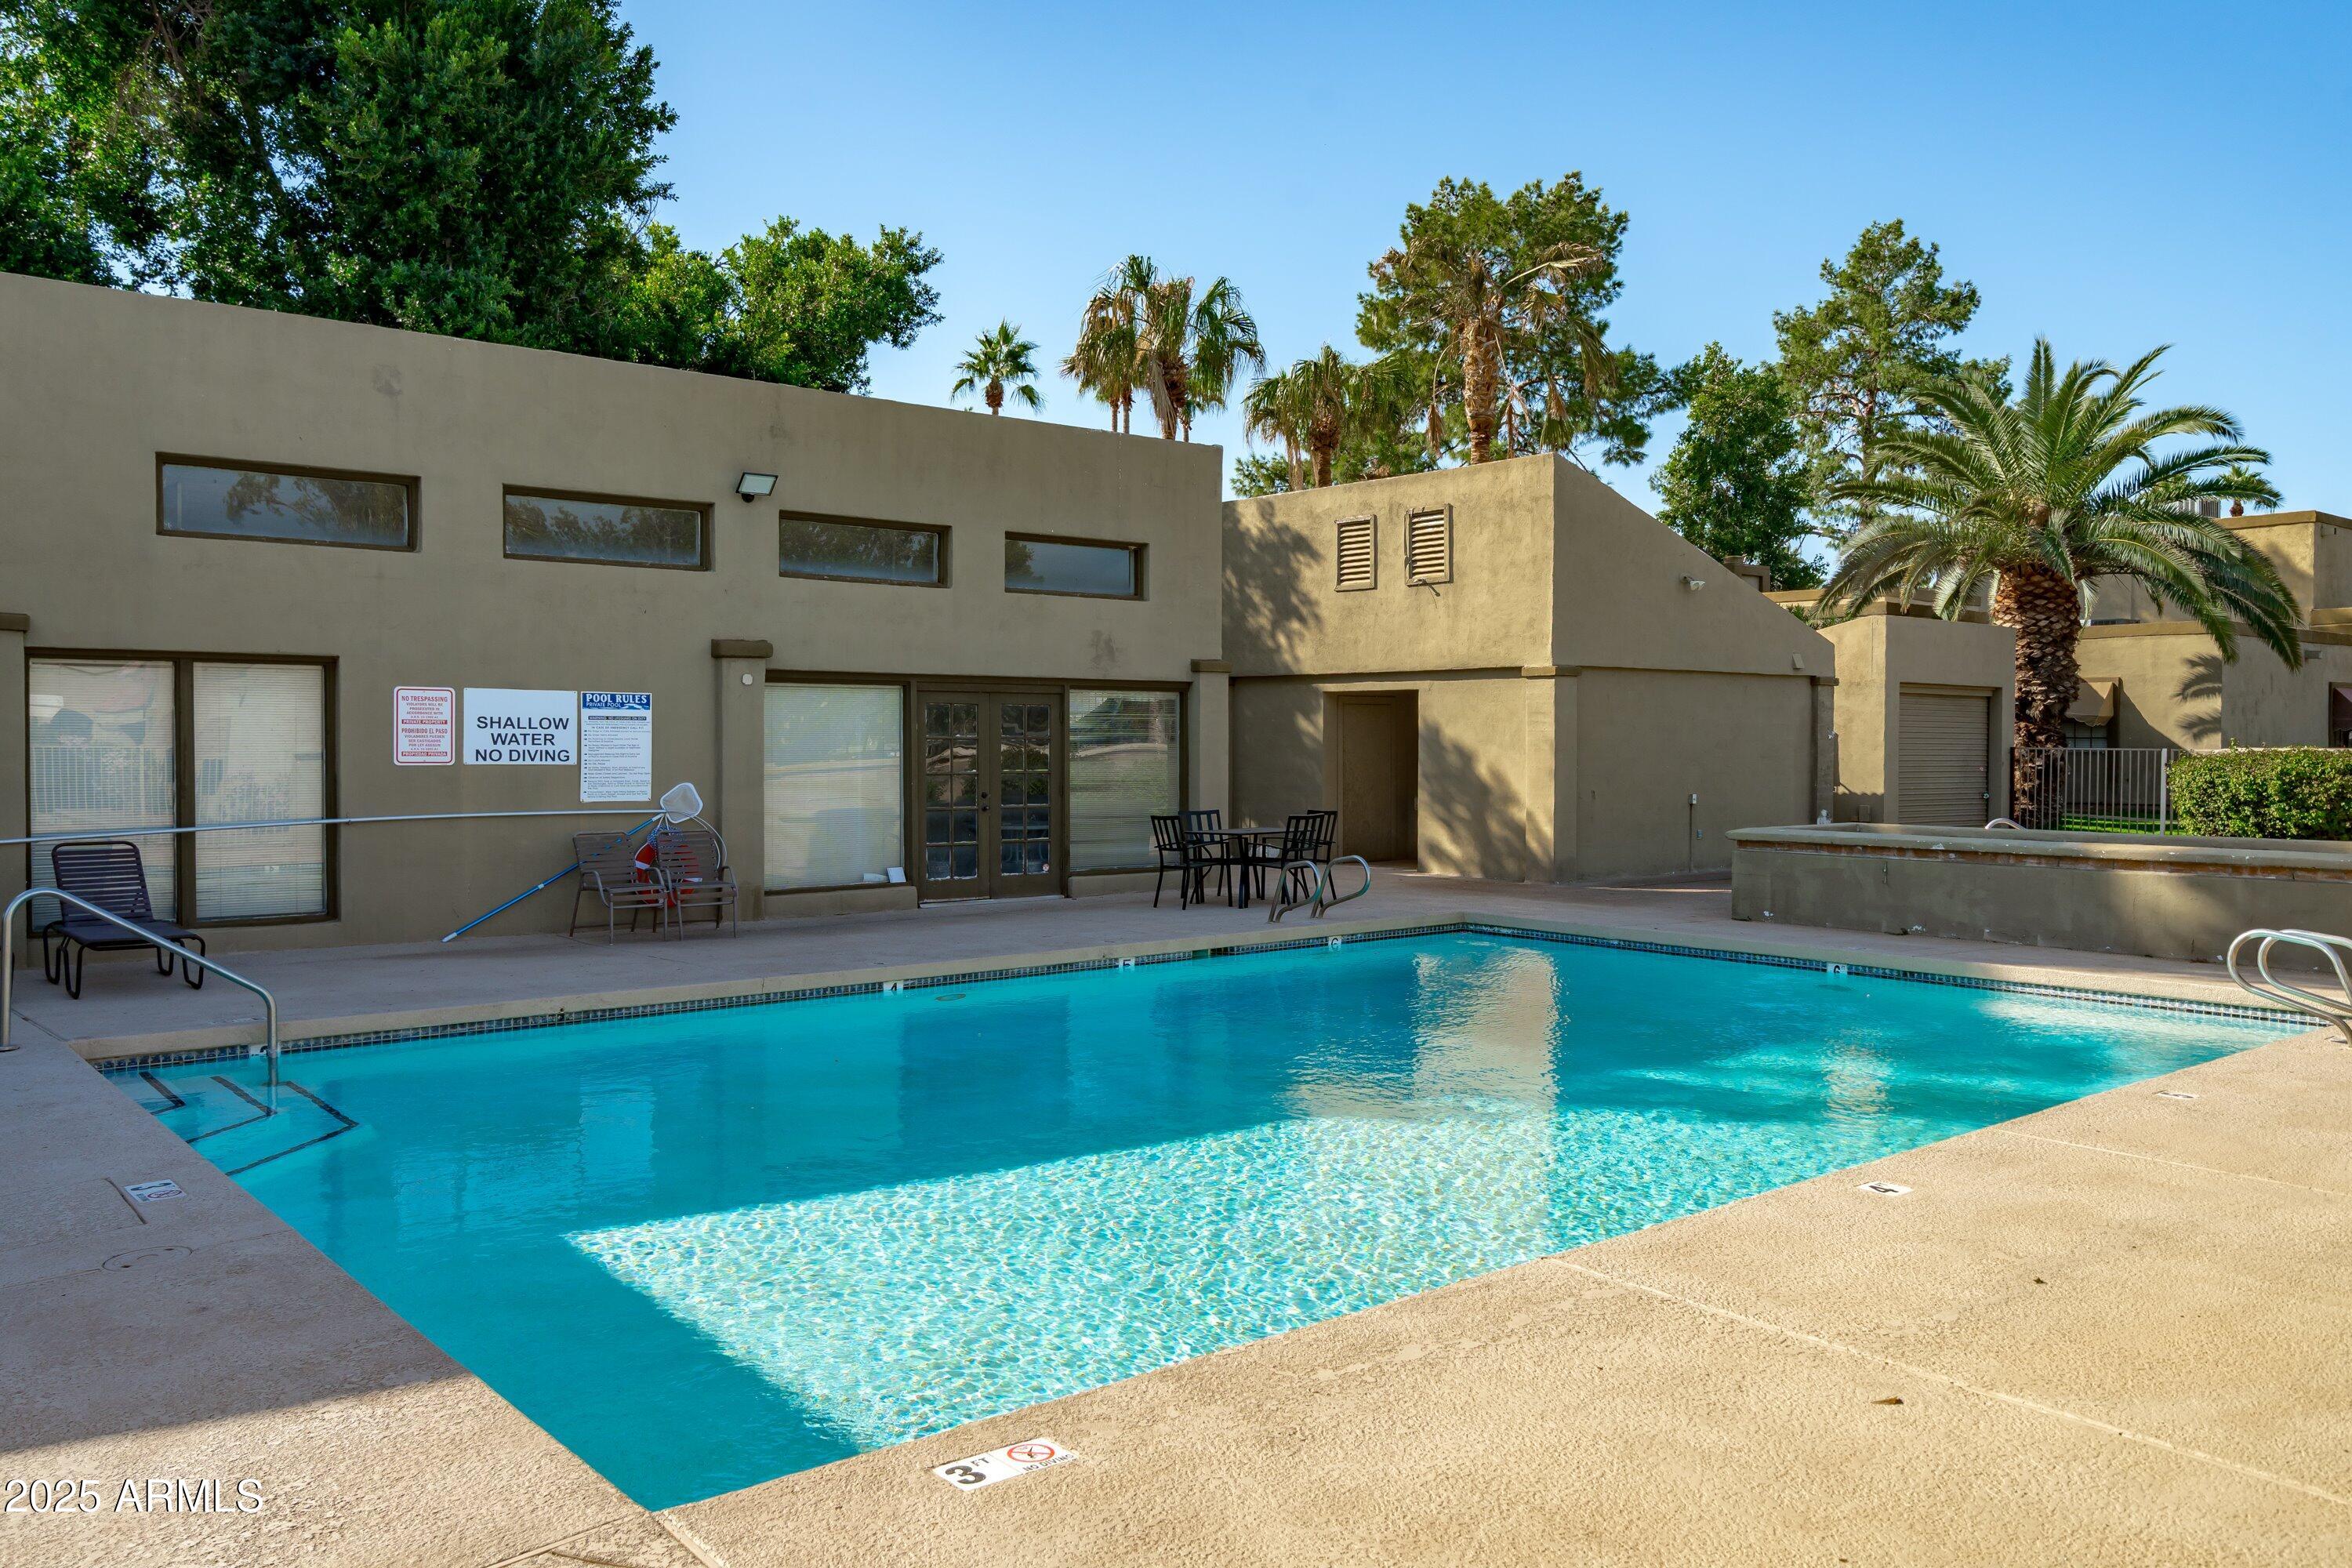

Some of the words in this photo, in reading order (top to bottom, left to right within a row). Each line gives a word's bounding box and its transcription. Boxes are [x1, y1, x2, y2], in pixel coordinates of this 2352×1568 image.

[586, 693, 612, 702] POOL
[615, 694, 648, 703] RULES
[477, 716, 569, 730] SHALLOW
[491, 733, 555, 746] WATER
[475, 749, 502, 762] NO
[509, 749, 570, 762] DIVING
[1040, 1454, 1074, 1468] DIVING
[945, 1465, 987, 1485] 3
[971, 1457, 991, 1468] FT
